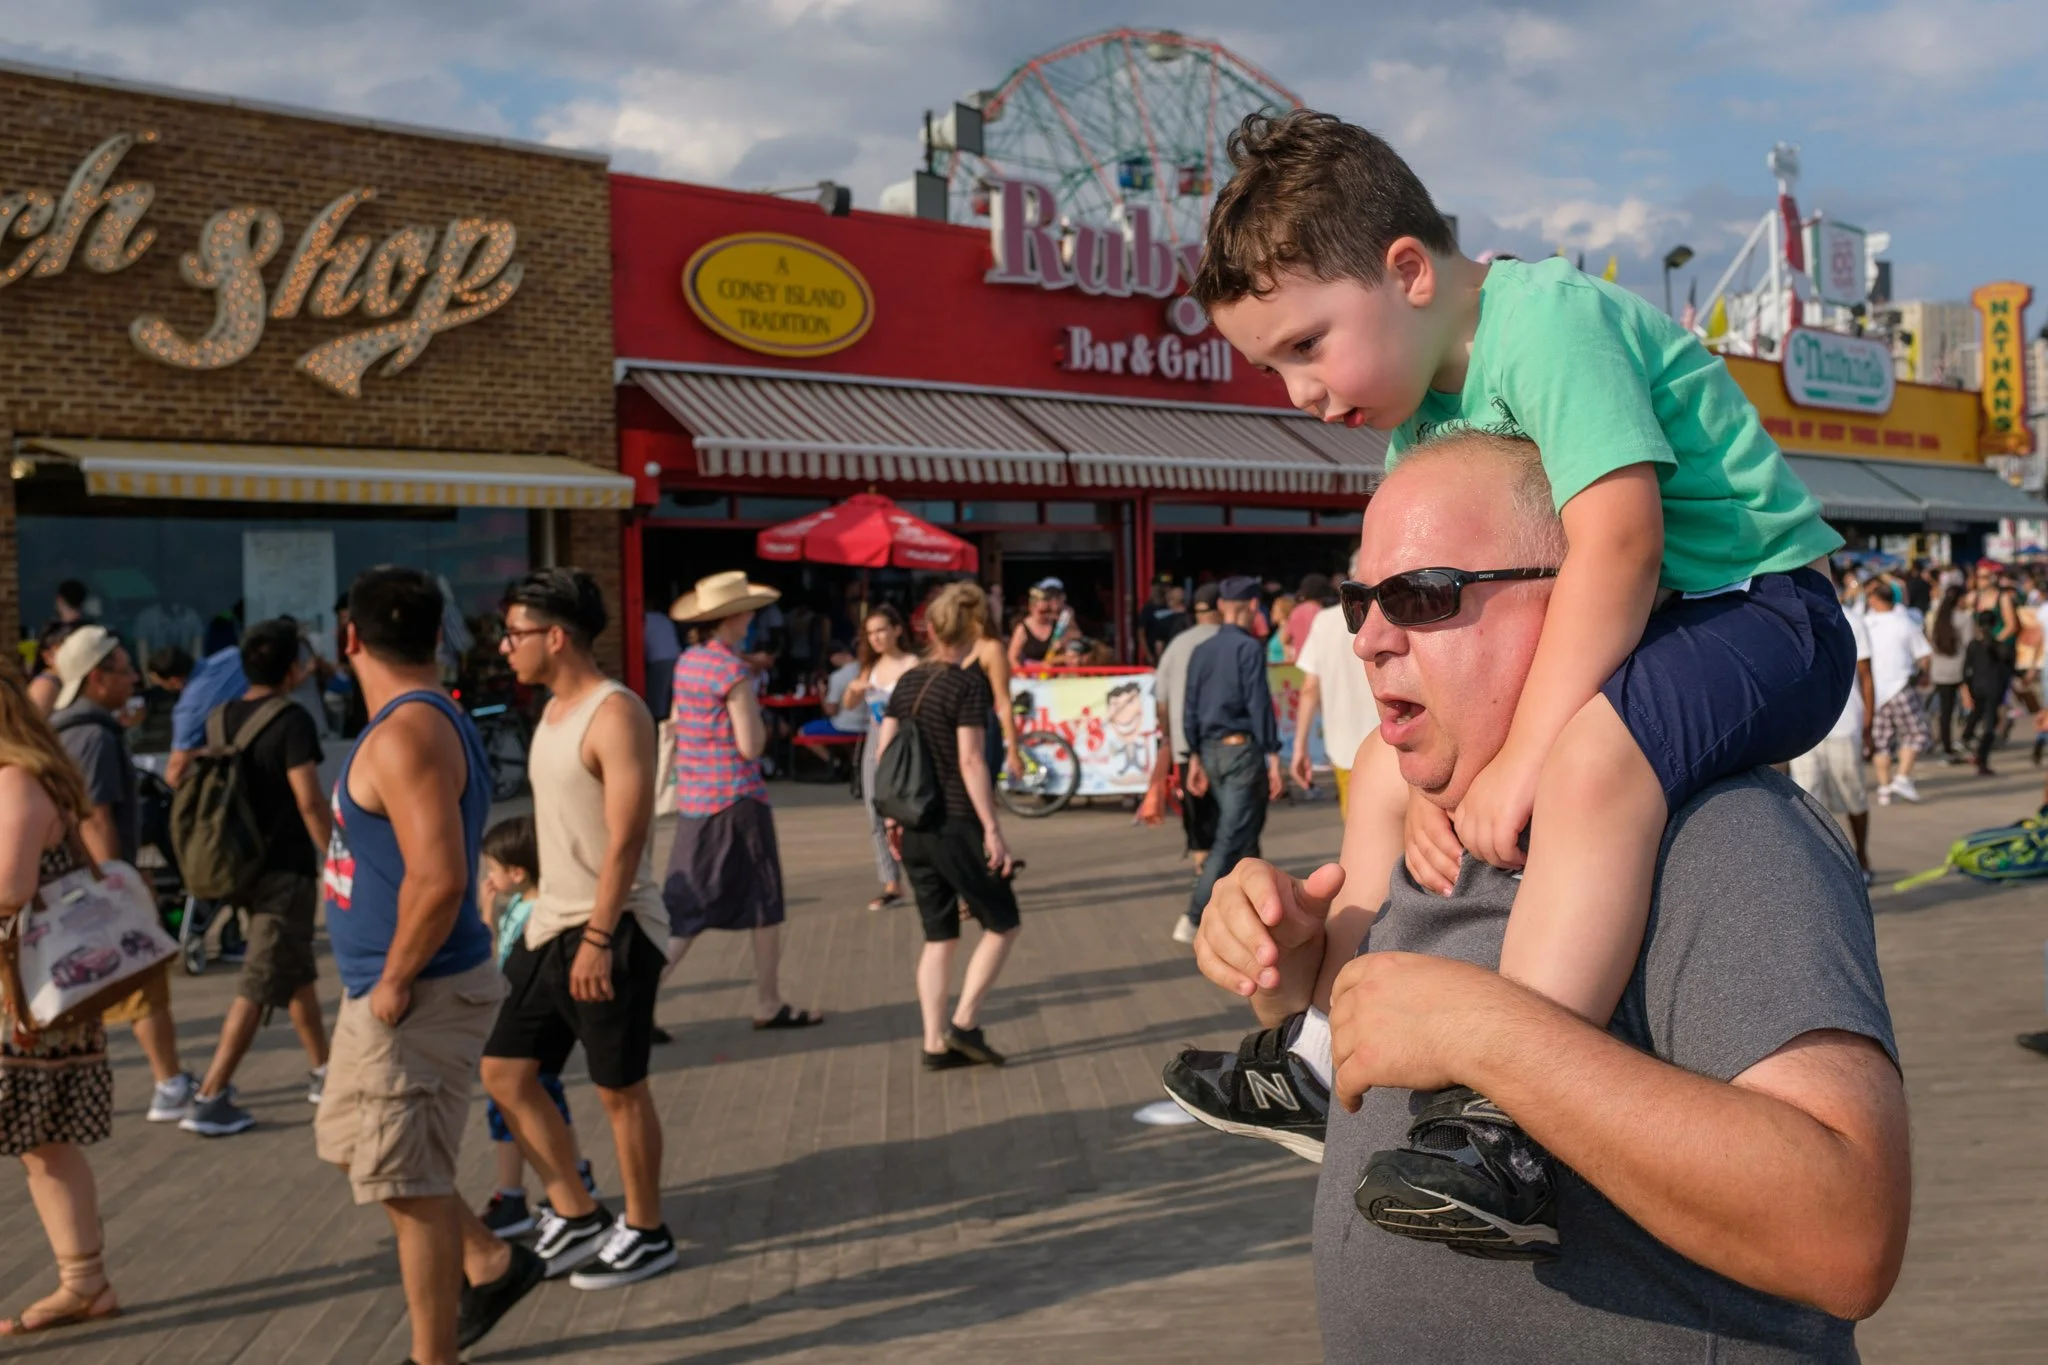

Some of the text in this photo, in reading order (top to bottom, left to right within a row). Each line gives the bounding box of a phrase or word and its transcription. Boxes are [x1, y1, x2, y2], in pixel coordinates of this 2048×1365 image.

[775, 256, 789, 276] A
[129, 187, 524, 399] Shop
[717, 278, 846, 310] CONEY ISLAND
[738, 307, 831, 336] TRADITION
[1245, 1069, 1301, 1112] N
